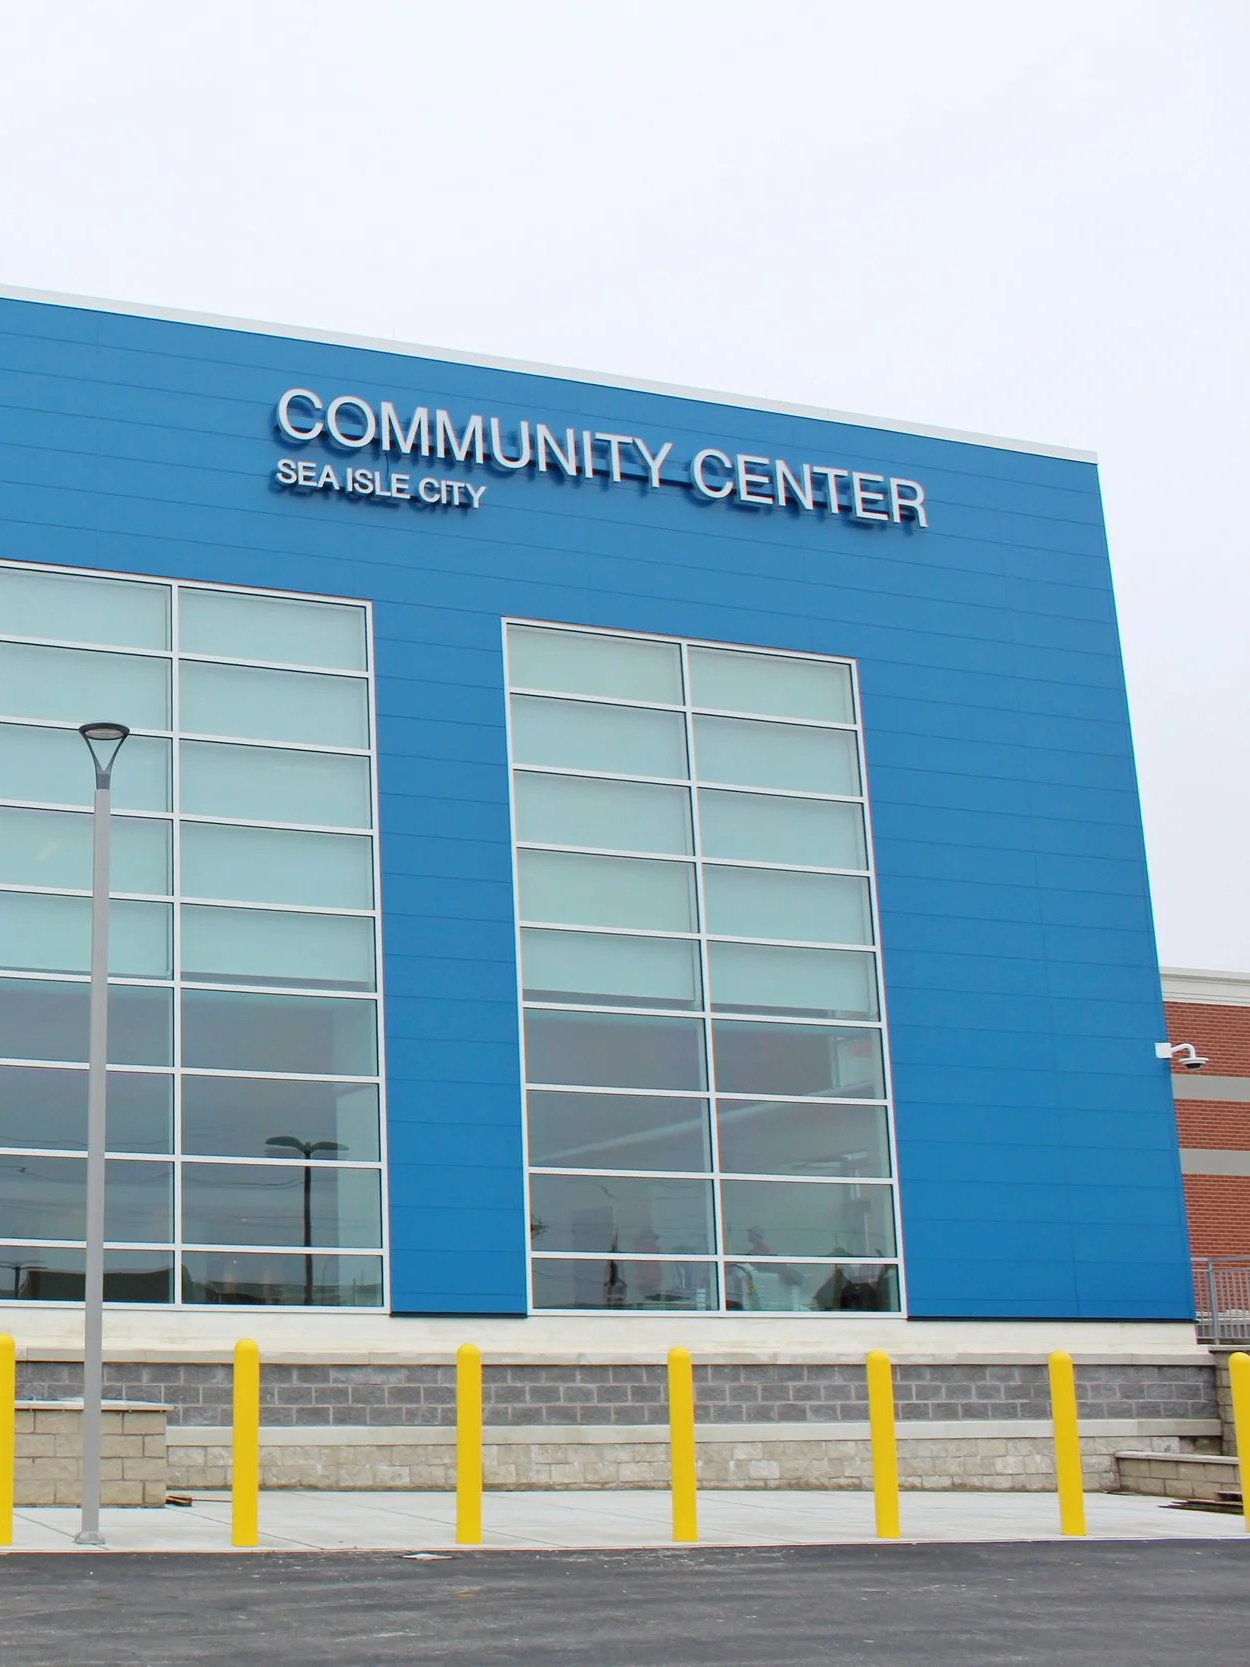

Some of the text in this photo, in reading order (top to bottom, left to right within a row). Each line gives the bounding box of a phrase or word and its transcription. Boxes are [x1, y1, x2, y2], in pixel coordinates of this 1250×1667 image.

[276, 458, 487, 509] SEA ISLE CITY
[277, 388, 928, 528] COMMUNITY CENTER
